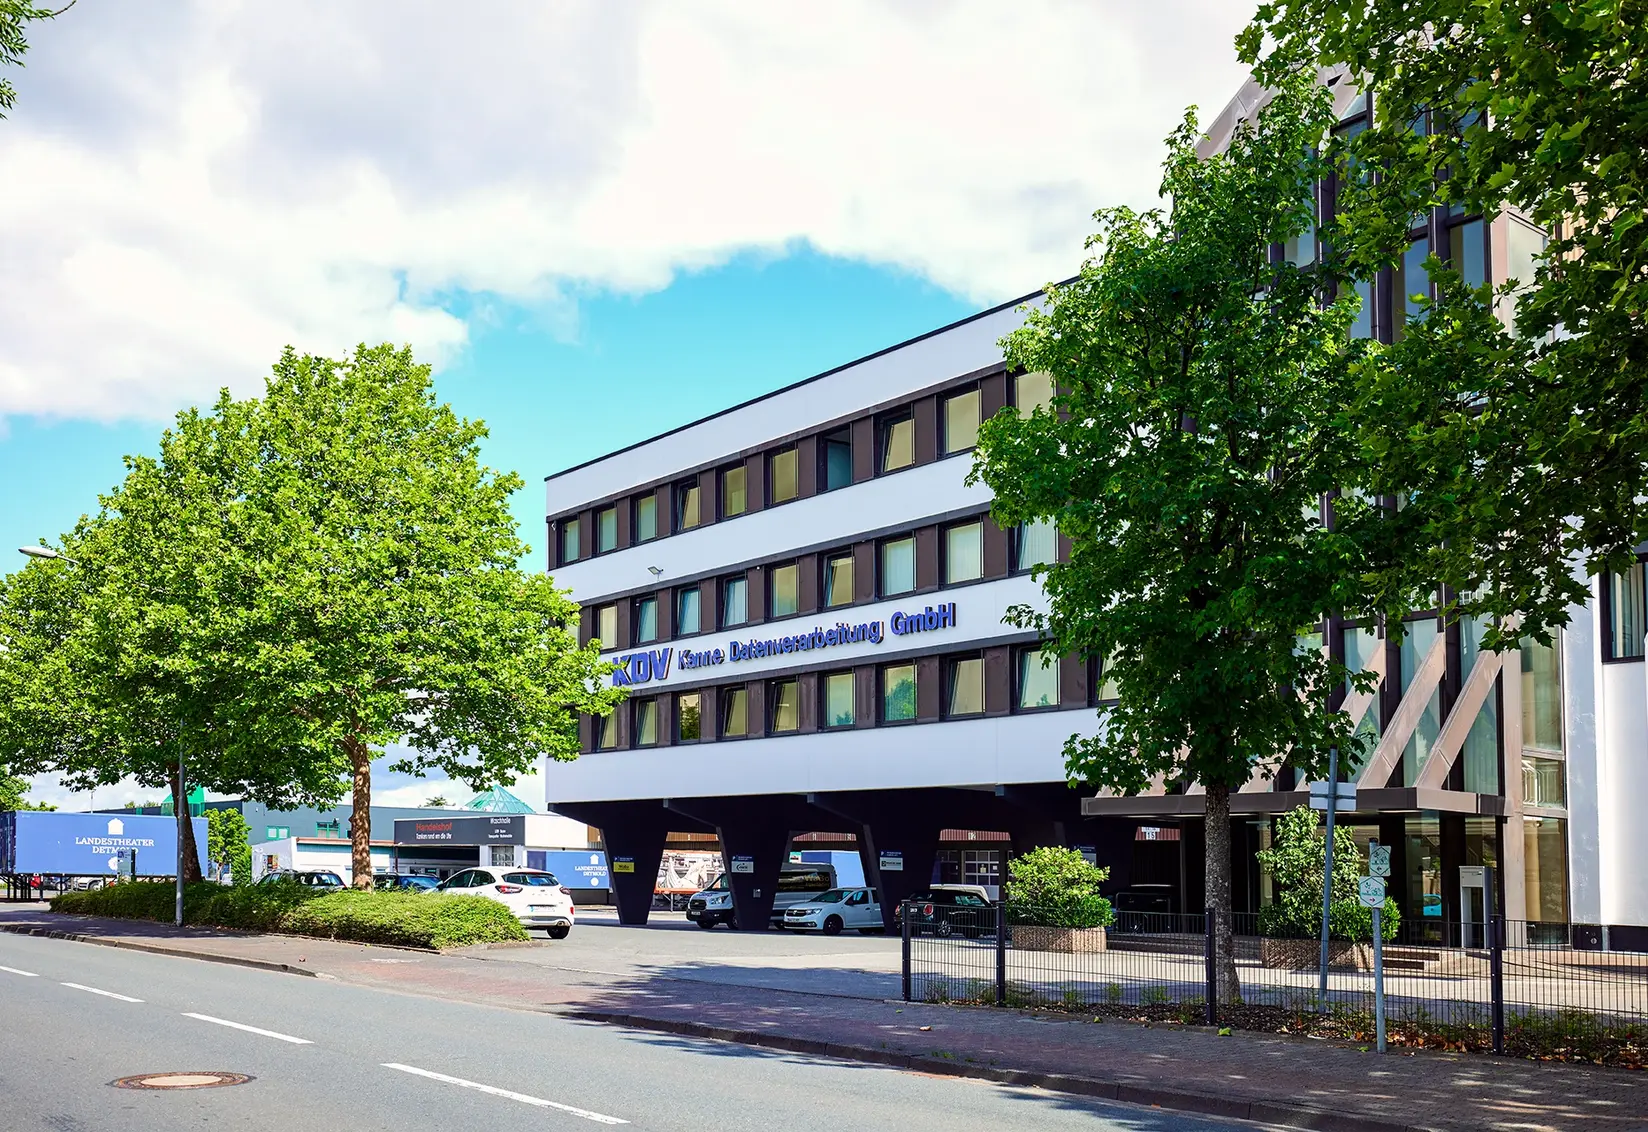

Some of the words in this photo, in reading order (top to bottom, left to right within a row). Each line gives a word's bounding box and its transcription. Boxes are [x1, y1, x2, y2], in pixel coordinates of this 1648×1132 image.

[612, 647, 672, 686] KDV
[678, 649, 724, 670] Kanne
[729, 620, 885, 662] Datenverarbeitung
[890, 602, 957, 636] GmbH
[415, 822, 453, 831] Handelshof
[75, 837, 155, 847] LANDESTHEATER
